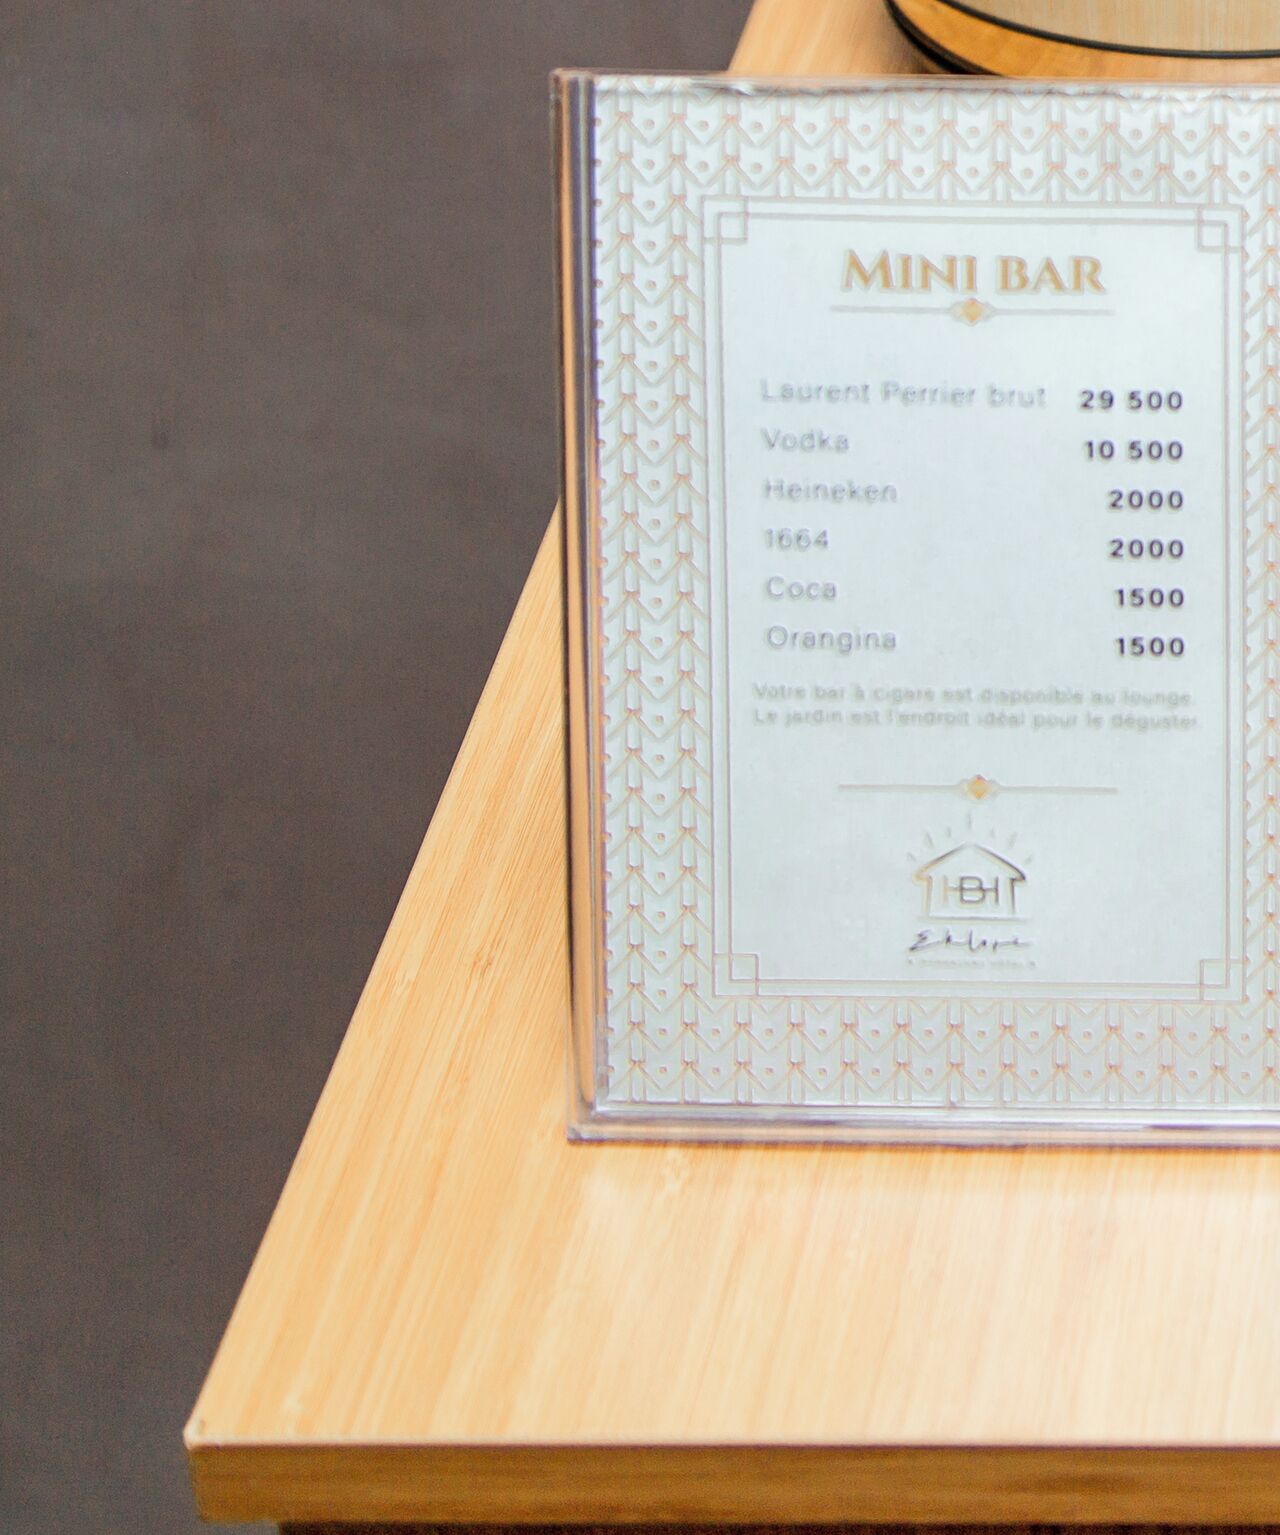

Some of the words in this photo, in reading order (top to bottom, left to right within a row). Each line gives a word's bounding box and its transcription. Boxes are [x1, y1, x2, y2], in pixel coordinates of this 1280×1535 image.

[840, 248, 978, 293] MINI
[996, 255, 1107, 295] BAR
[759, 378, 871, 406] Laurent
[881, 380, 977, 409] Perrier
[986, 382, 1048, 409] brut
[1079, 389, 1115, 411] 29
[1127, 390, 1184, 412] 500
[759, 428, 851, 454] Vodka
[1084, 439, 1115, 461] 10
[1127, 440, 1184, 462] 500
[762, 477, 898, 505] Heineken
[1108, 489, 1184, 511] 2000
[763, 527, 830, 553] 1664
[1109, 538, 1185, 560] 2000
[764, 575, 838, 603] Coca
[1114, 587, 1185, 609] 1500
[764, 625, 897, 656] Orangina
[1115, 636, 1185, 658] 1500
